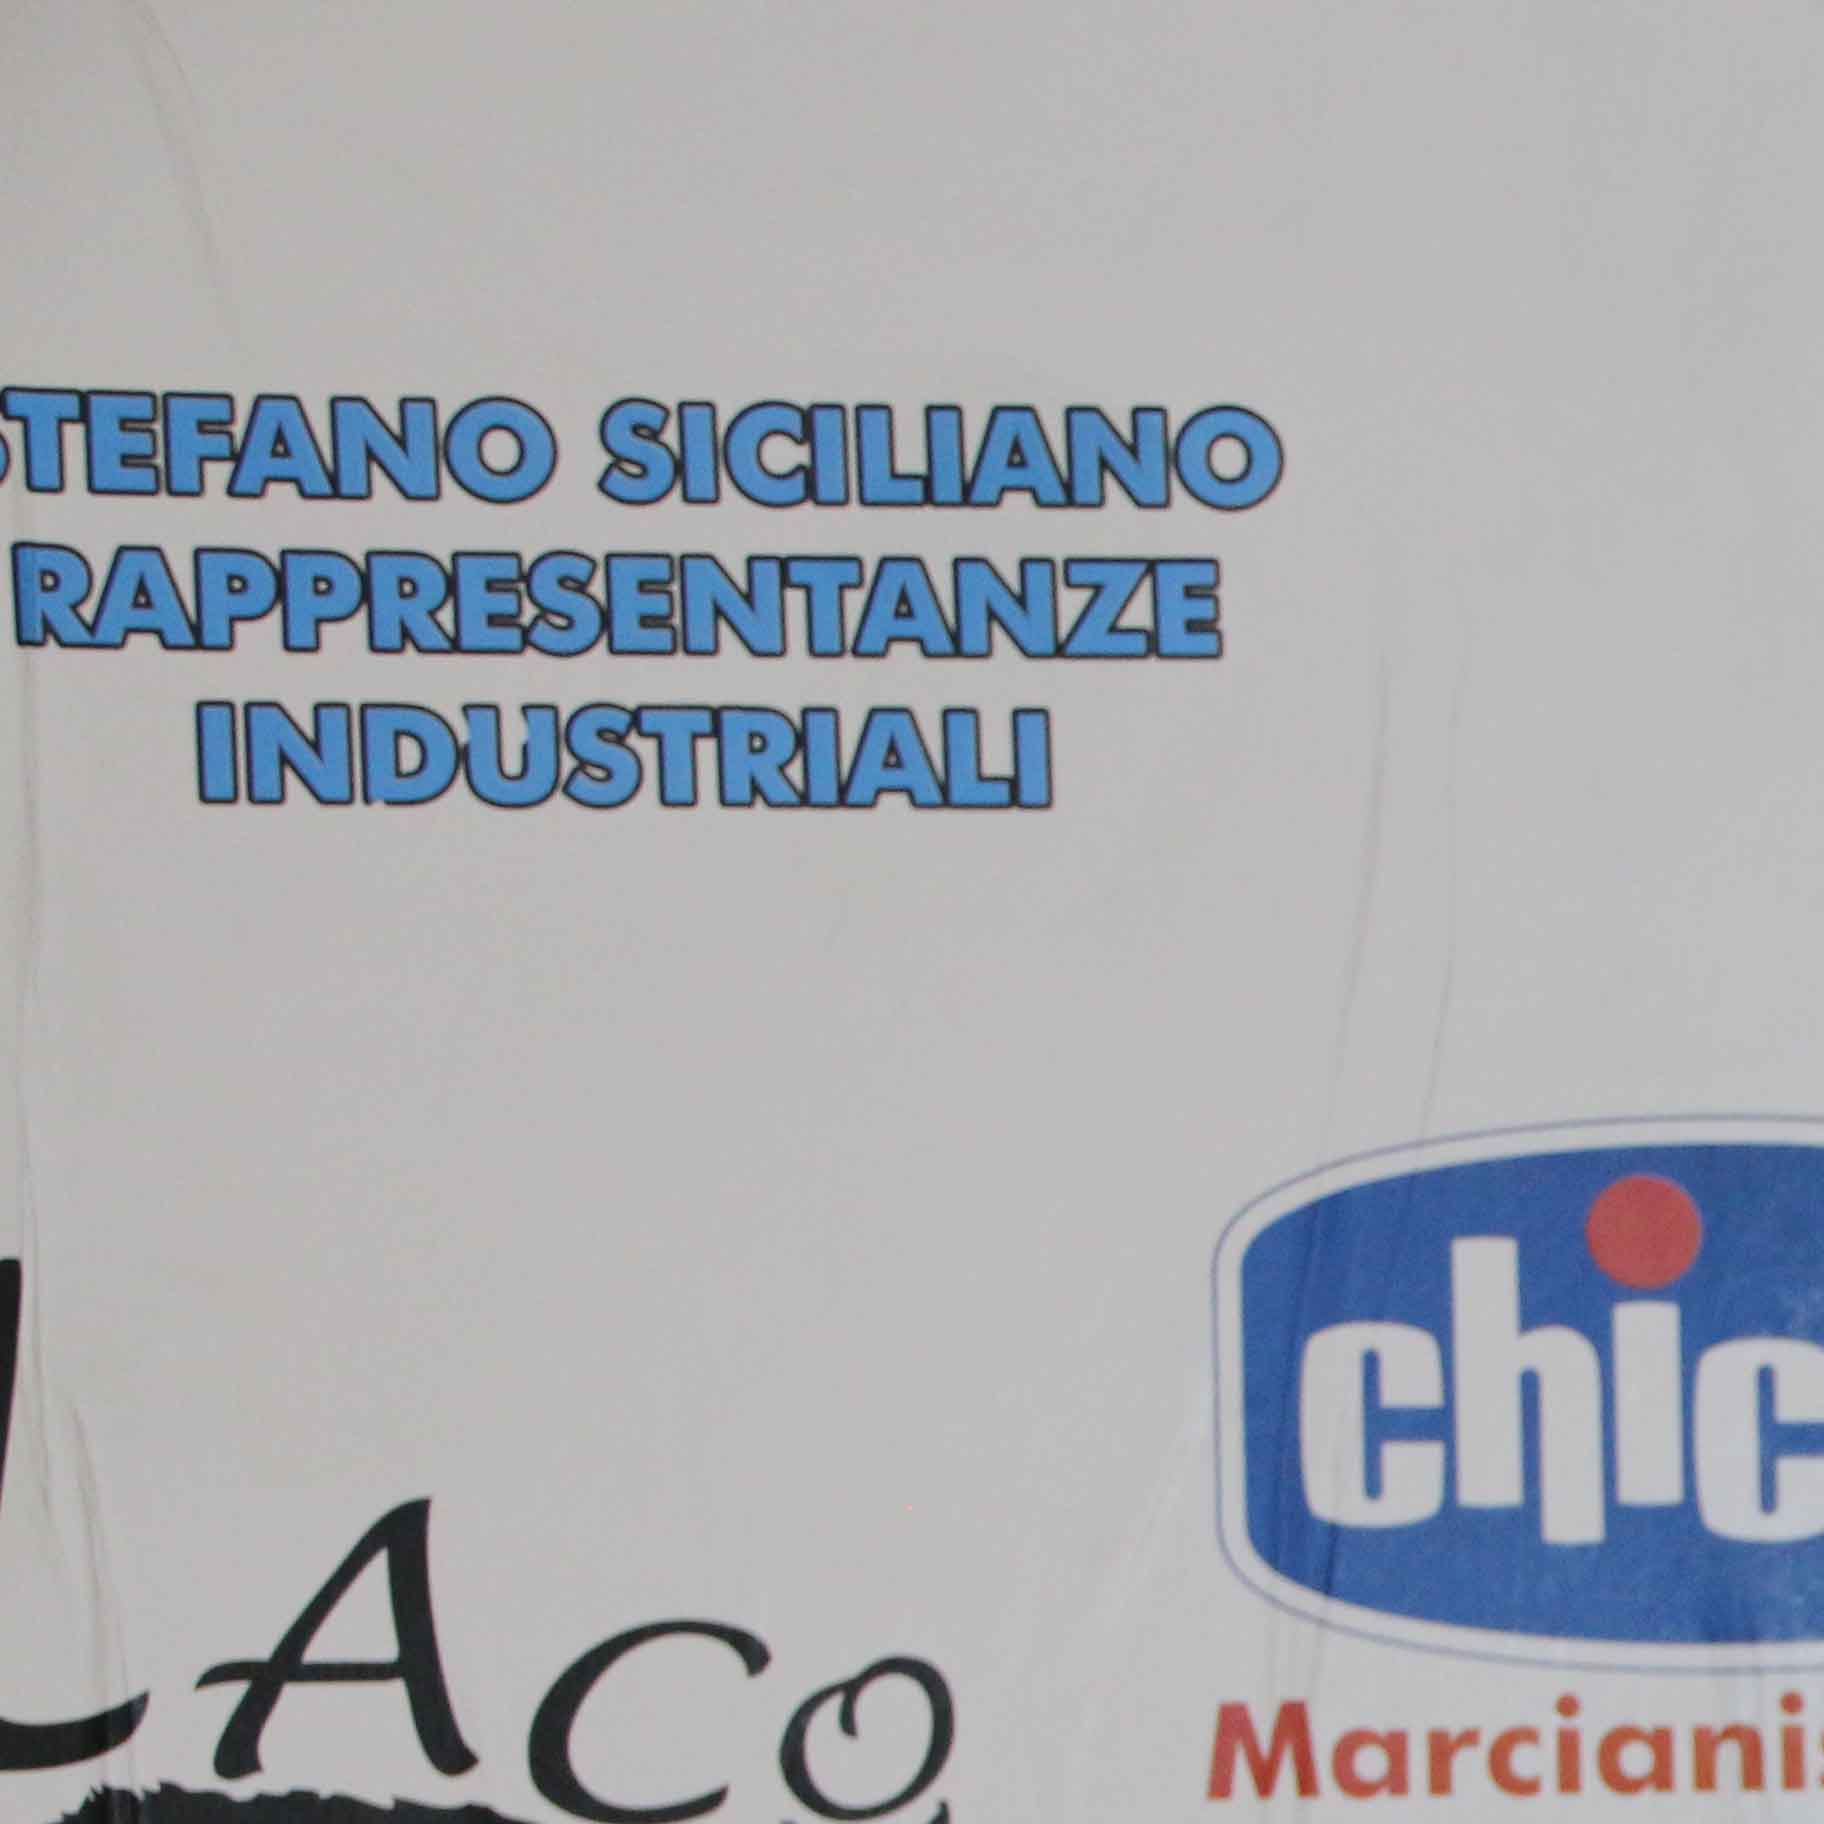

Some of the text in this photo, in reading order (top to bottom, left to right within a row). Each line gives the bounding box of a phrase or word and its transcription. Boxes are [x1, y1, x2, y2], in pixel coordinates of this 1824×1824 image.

[0, 386, 1284, 510] TEFANO SICILIANO
[12, 542, 1222, 659] RAPPRESENTANZE
[196, 702, 1053, 808] INDUSTRIALI
